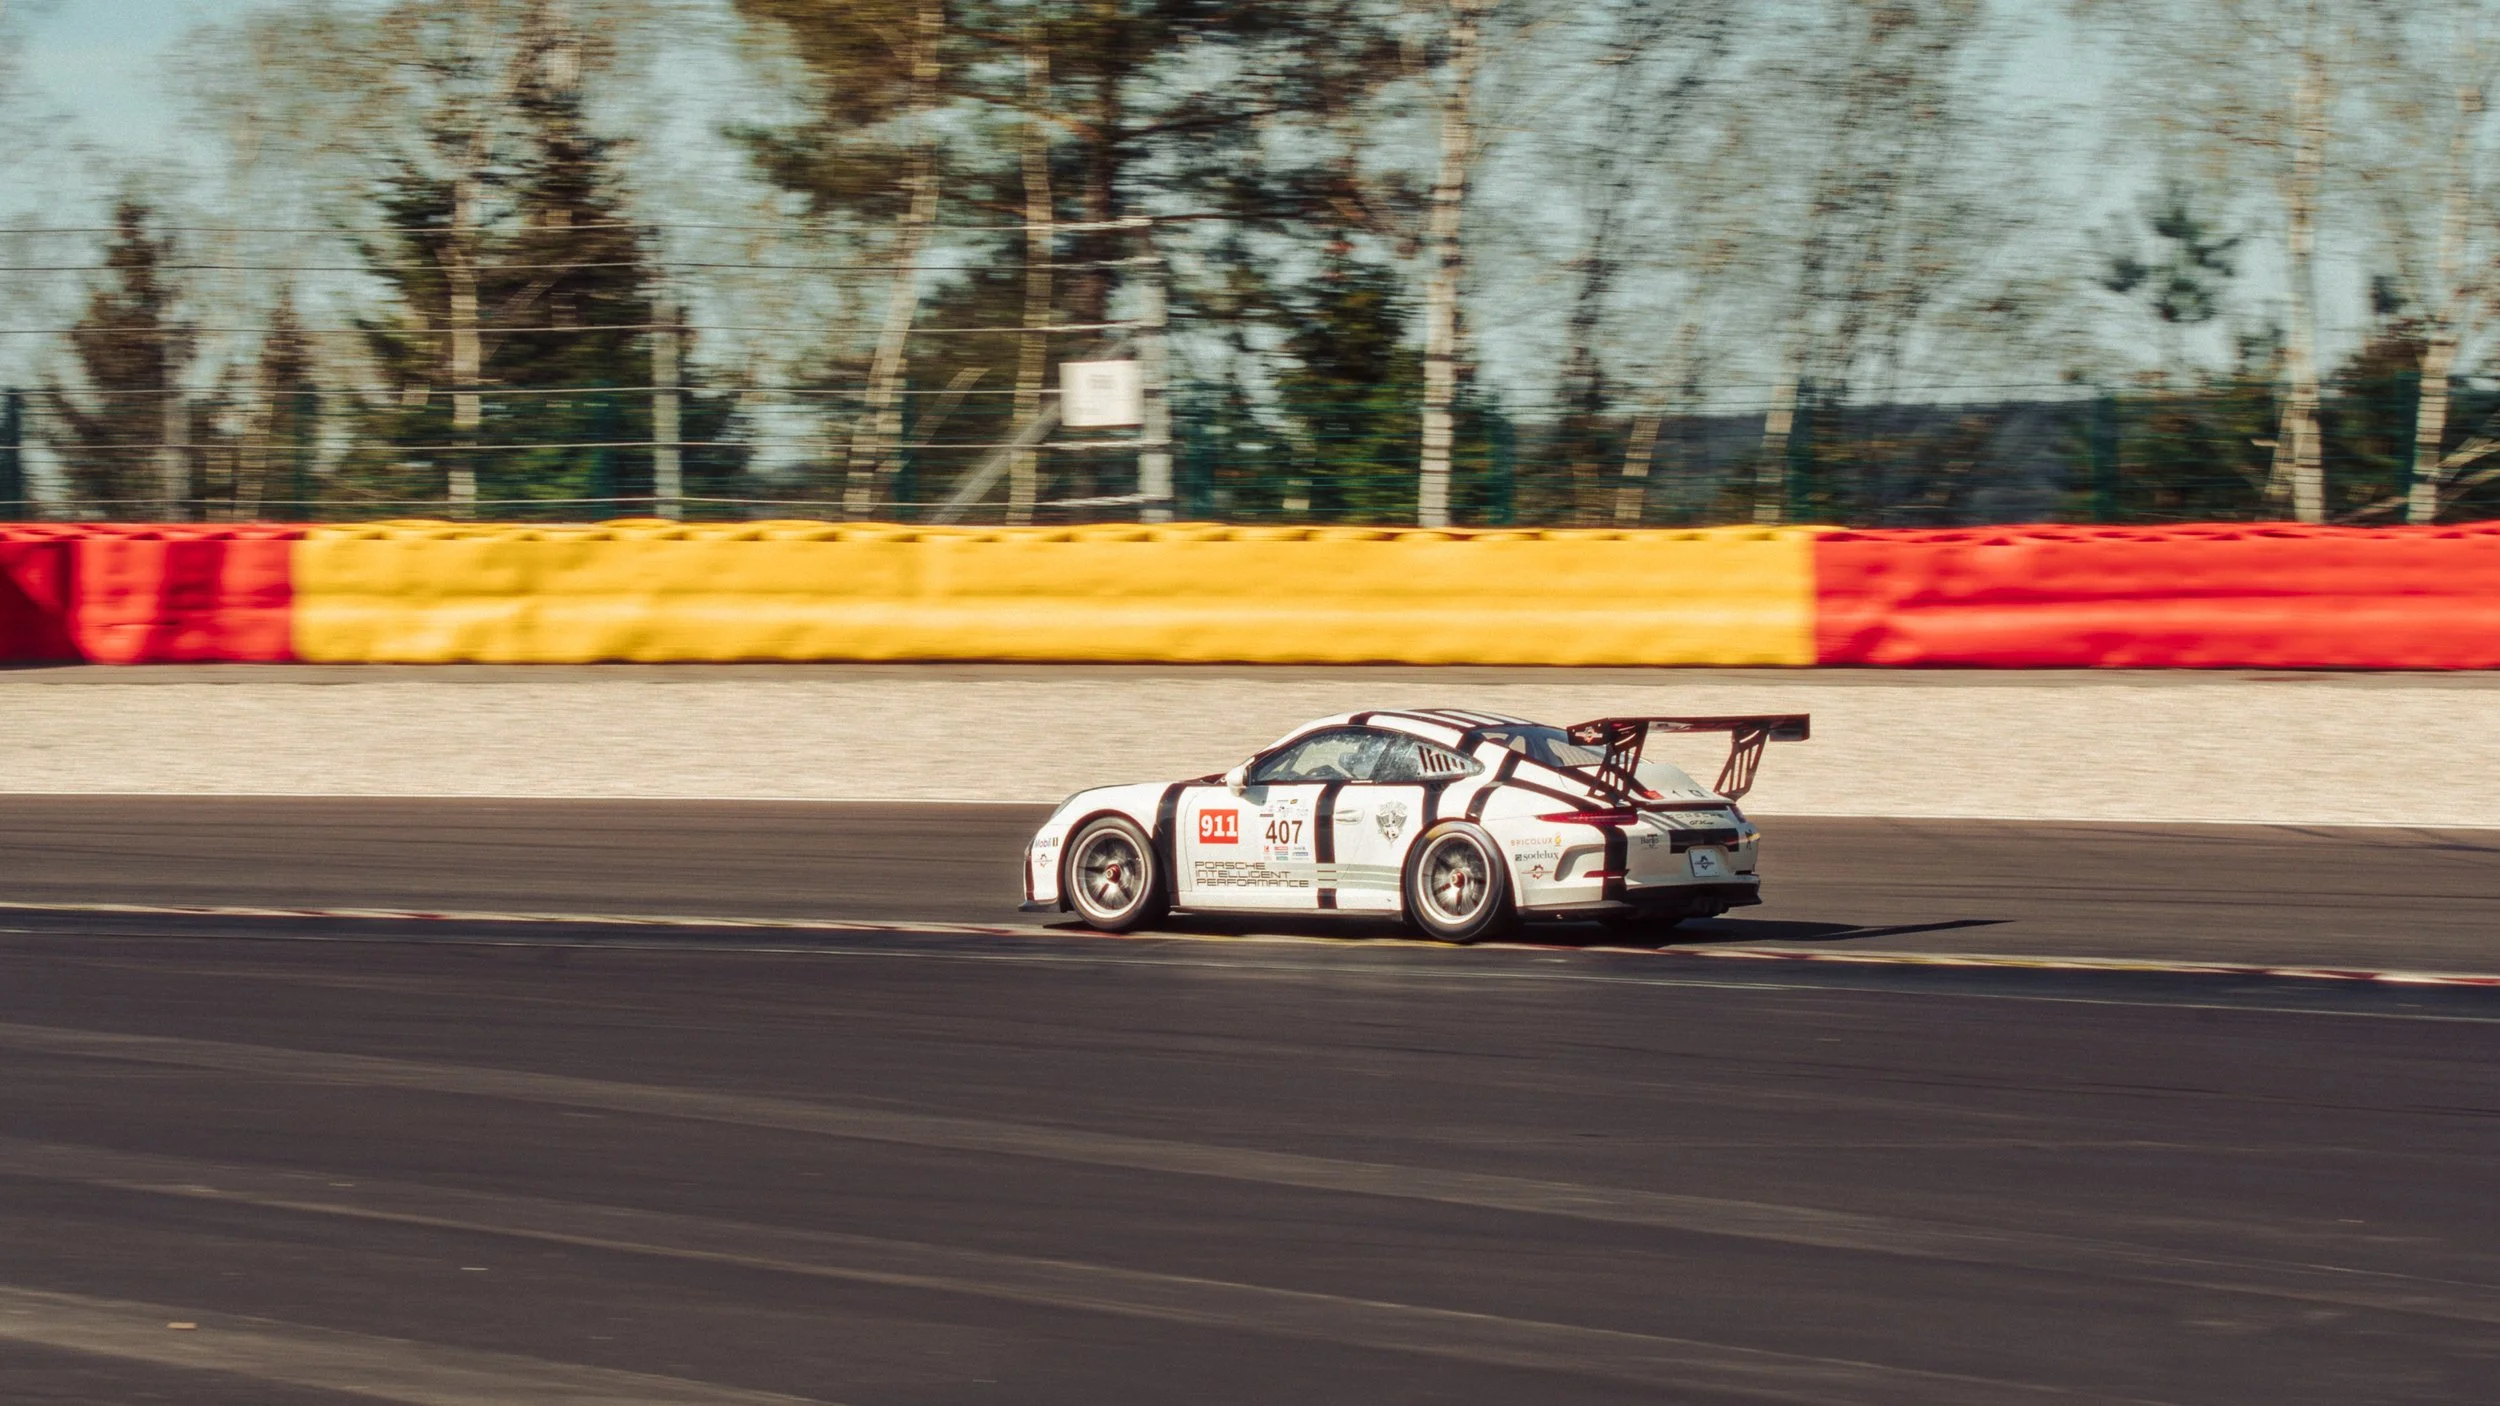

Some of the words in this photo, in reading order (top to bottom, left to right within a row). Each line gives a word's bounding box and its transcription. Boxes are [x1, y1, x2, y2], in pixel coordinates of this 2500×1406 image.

[1200, 815, 1238, 837] 911
[1265, 820, 1303, 844] 407
[1511, 837, 1553, 847] BRICOLUX
[1523, 850, 1559, 861] sodelux
[1195, 861, 1266, 870] PORSCHE
[1196, 870, 1291, 879] INTELLIGENT
[1197, 879, 1309, 888] PERFORMANCE
